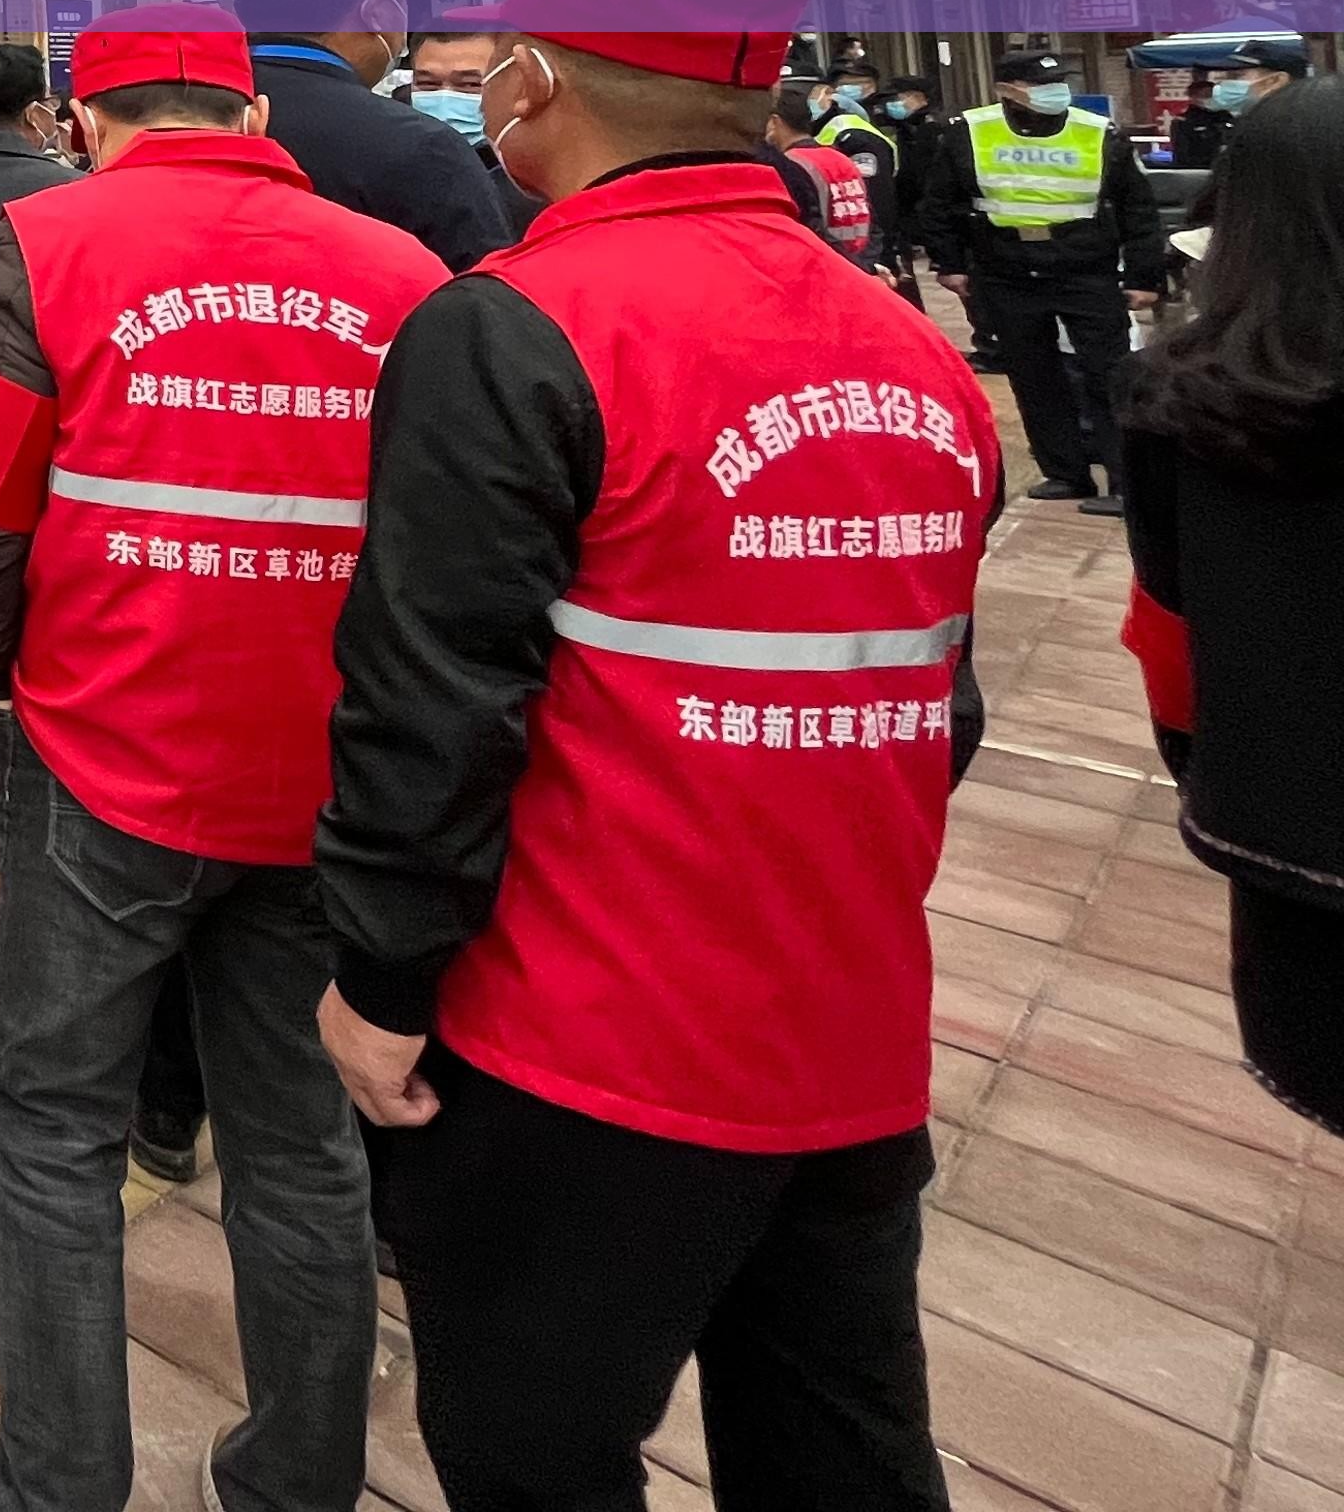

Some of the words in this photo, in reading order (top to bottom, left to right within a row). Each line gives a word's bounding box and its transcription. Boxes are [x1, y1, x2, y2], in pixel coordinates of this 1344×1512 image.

[997, 149, 1077, 165] POLICE
[127, 373, 375, 420] 战旗红志愿服务队
[705, 379, 981, 498] 成都市退役军人
[729, 510, 964, 559] 战旗红志愿服务队
